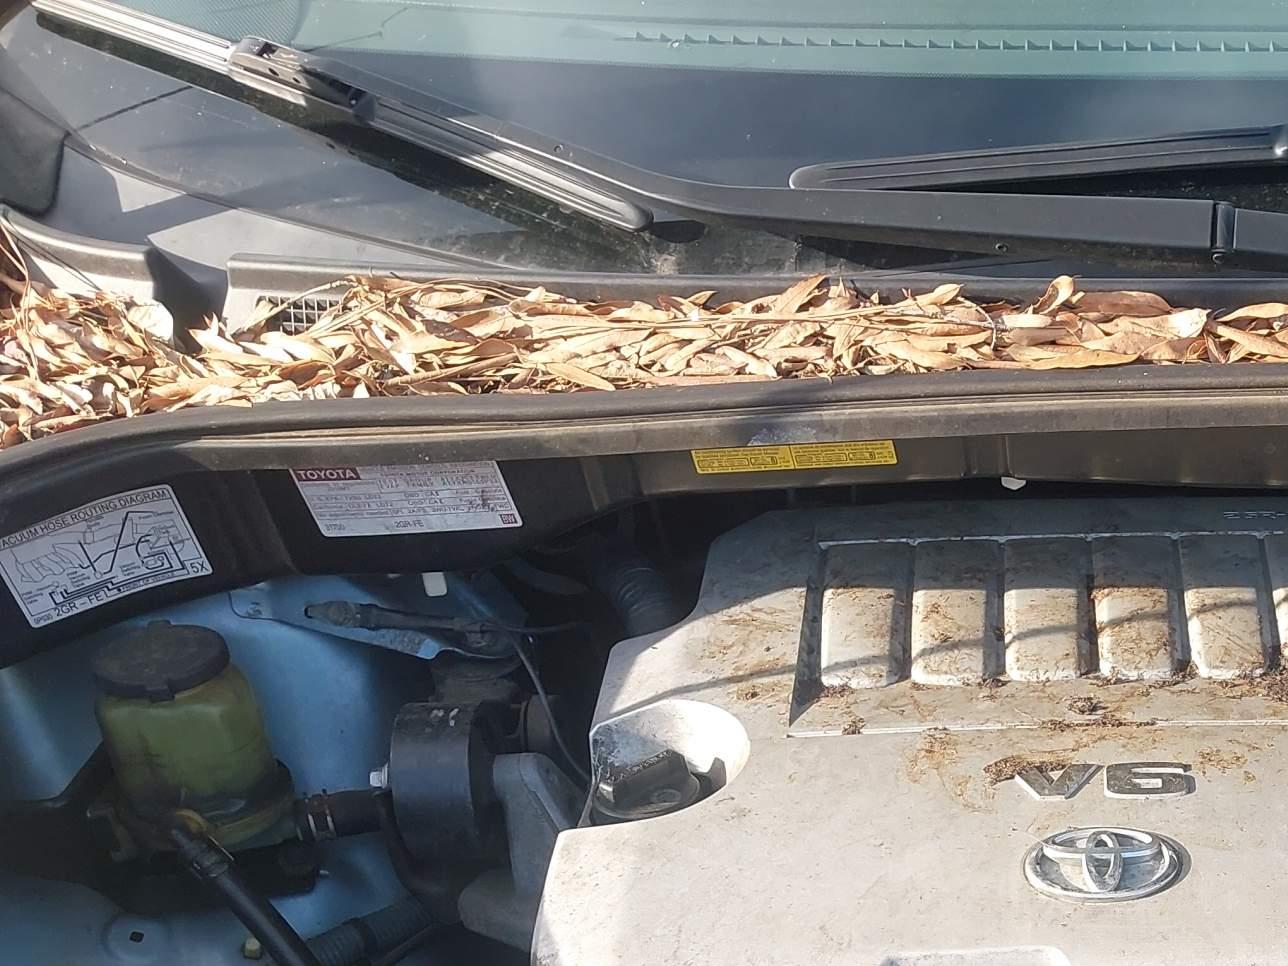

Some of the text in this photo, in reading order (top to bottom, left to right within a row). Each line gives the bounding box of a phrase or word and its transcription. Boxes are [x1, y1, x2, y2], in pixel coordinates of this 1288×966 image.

[297, 469, 357, 480] TOYOTA
[0, 528, 40, 548] ACUUM
[40, 516, 70, 535] HOSE
[71, 502, 118, 522] ROUTING
[118, 490, 167, 509] DIAGRAM
[190, 561, 210, 573] 5X
[1015, 761, 1196, 800] V6
